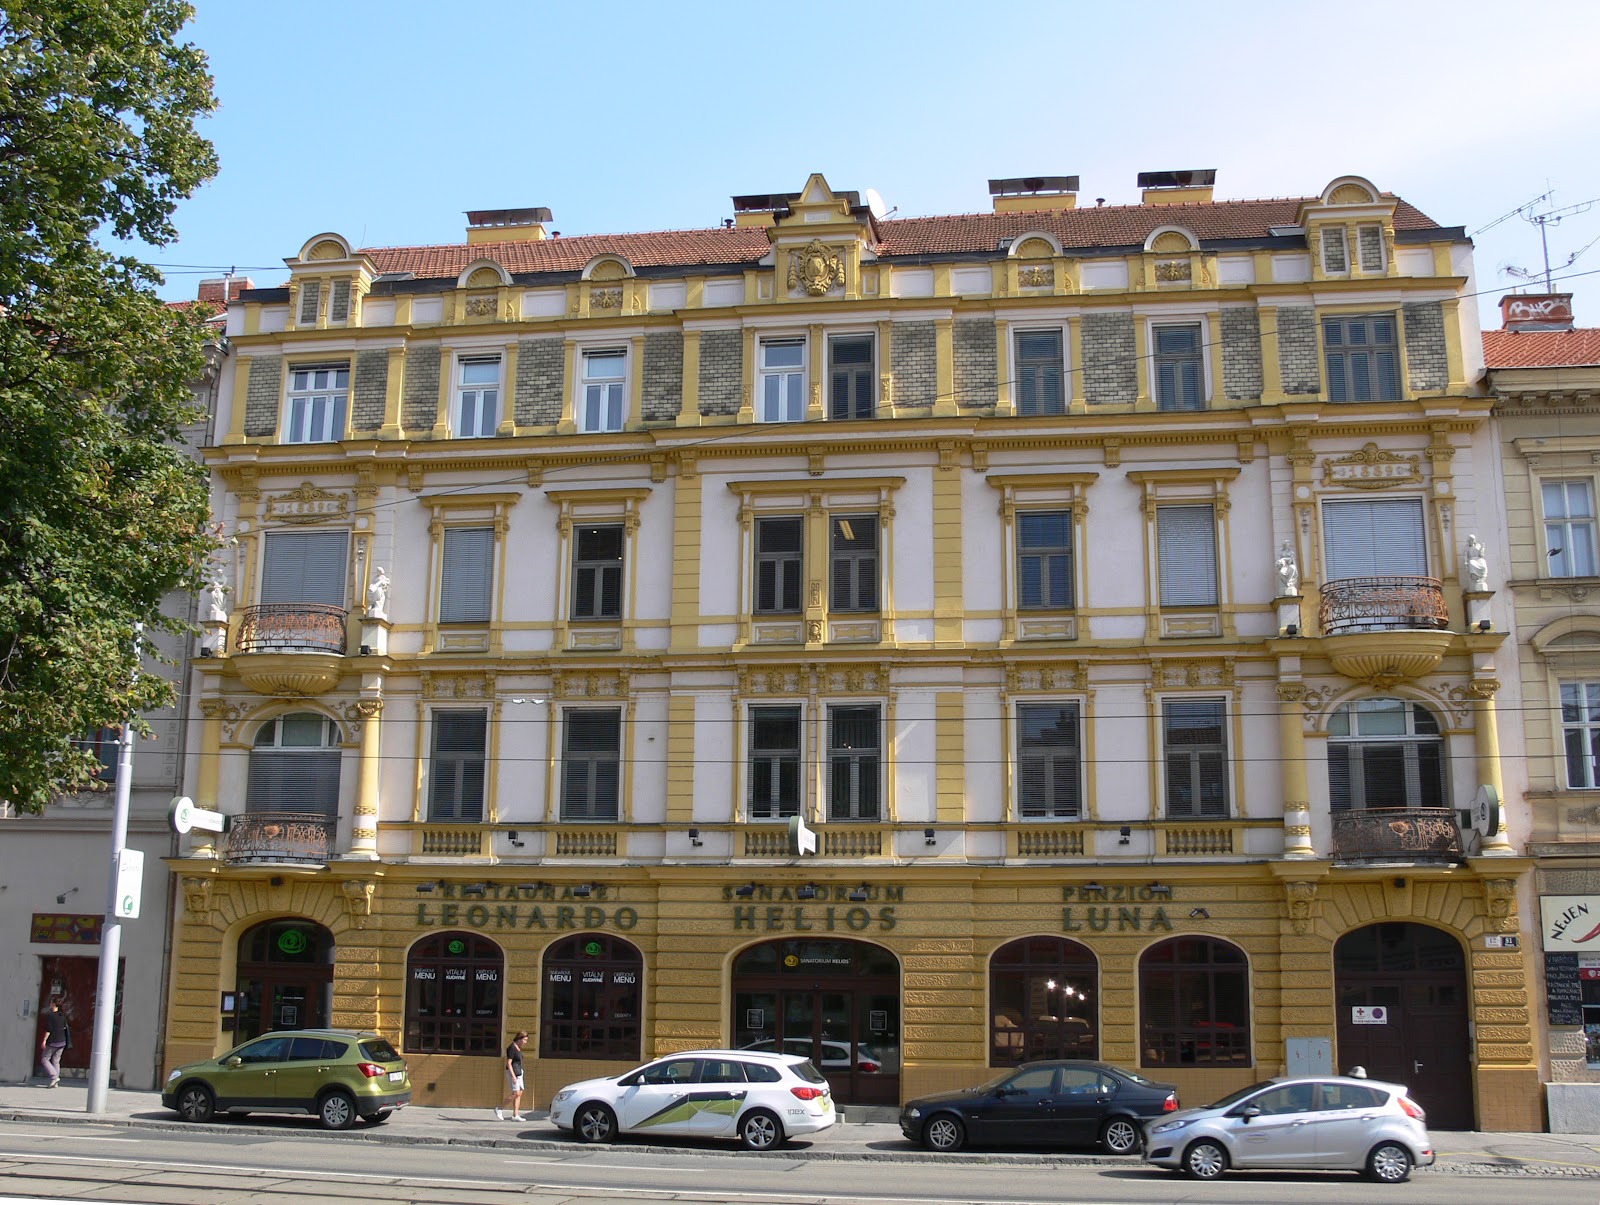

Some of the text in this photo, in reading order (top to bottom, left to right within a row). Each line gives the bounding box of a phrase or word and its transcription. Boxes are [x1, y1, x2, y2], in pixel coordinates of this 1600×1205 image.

[442, 884, 608, 900] RETAURAE
[722, 885, 905, 901] SNAORUM
[1062, 885, 1173, 901] PENZION
[417, 903, 639, 931] LEONARDO
[734, 906, 897, 931] HELIOS
[1062, 906, 1174, 932] LUNA
[1550, 902, 1589, 941] NEJEN
[414, 972, 436, 980] MENU
[475, 973, 498, 981] MENU
[549, 974, 572, 982] MENU
[613, 976, 636, 984] MENU
